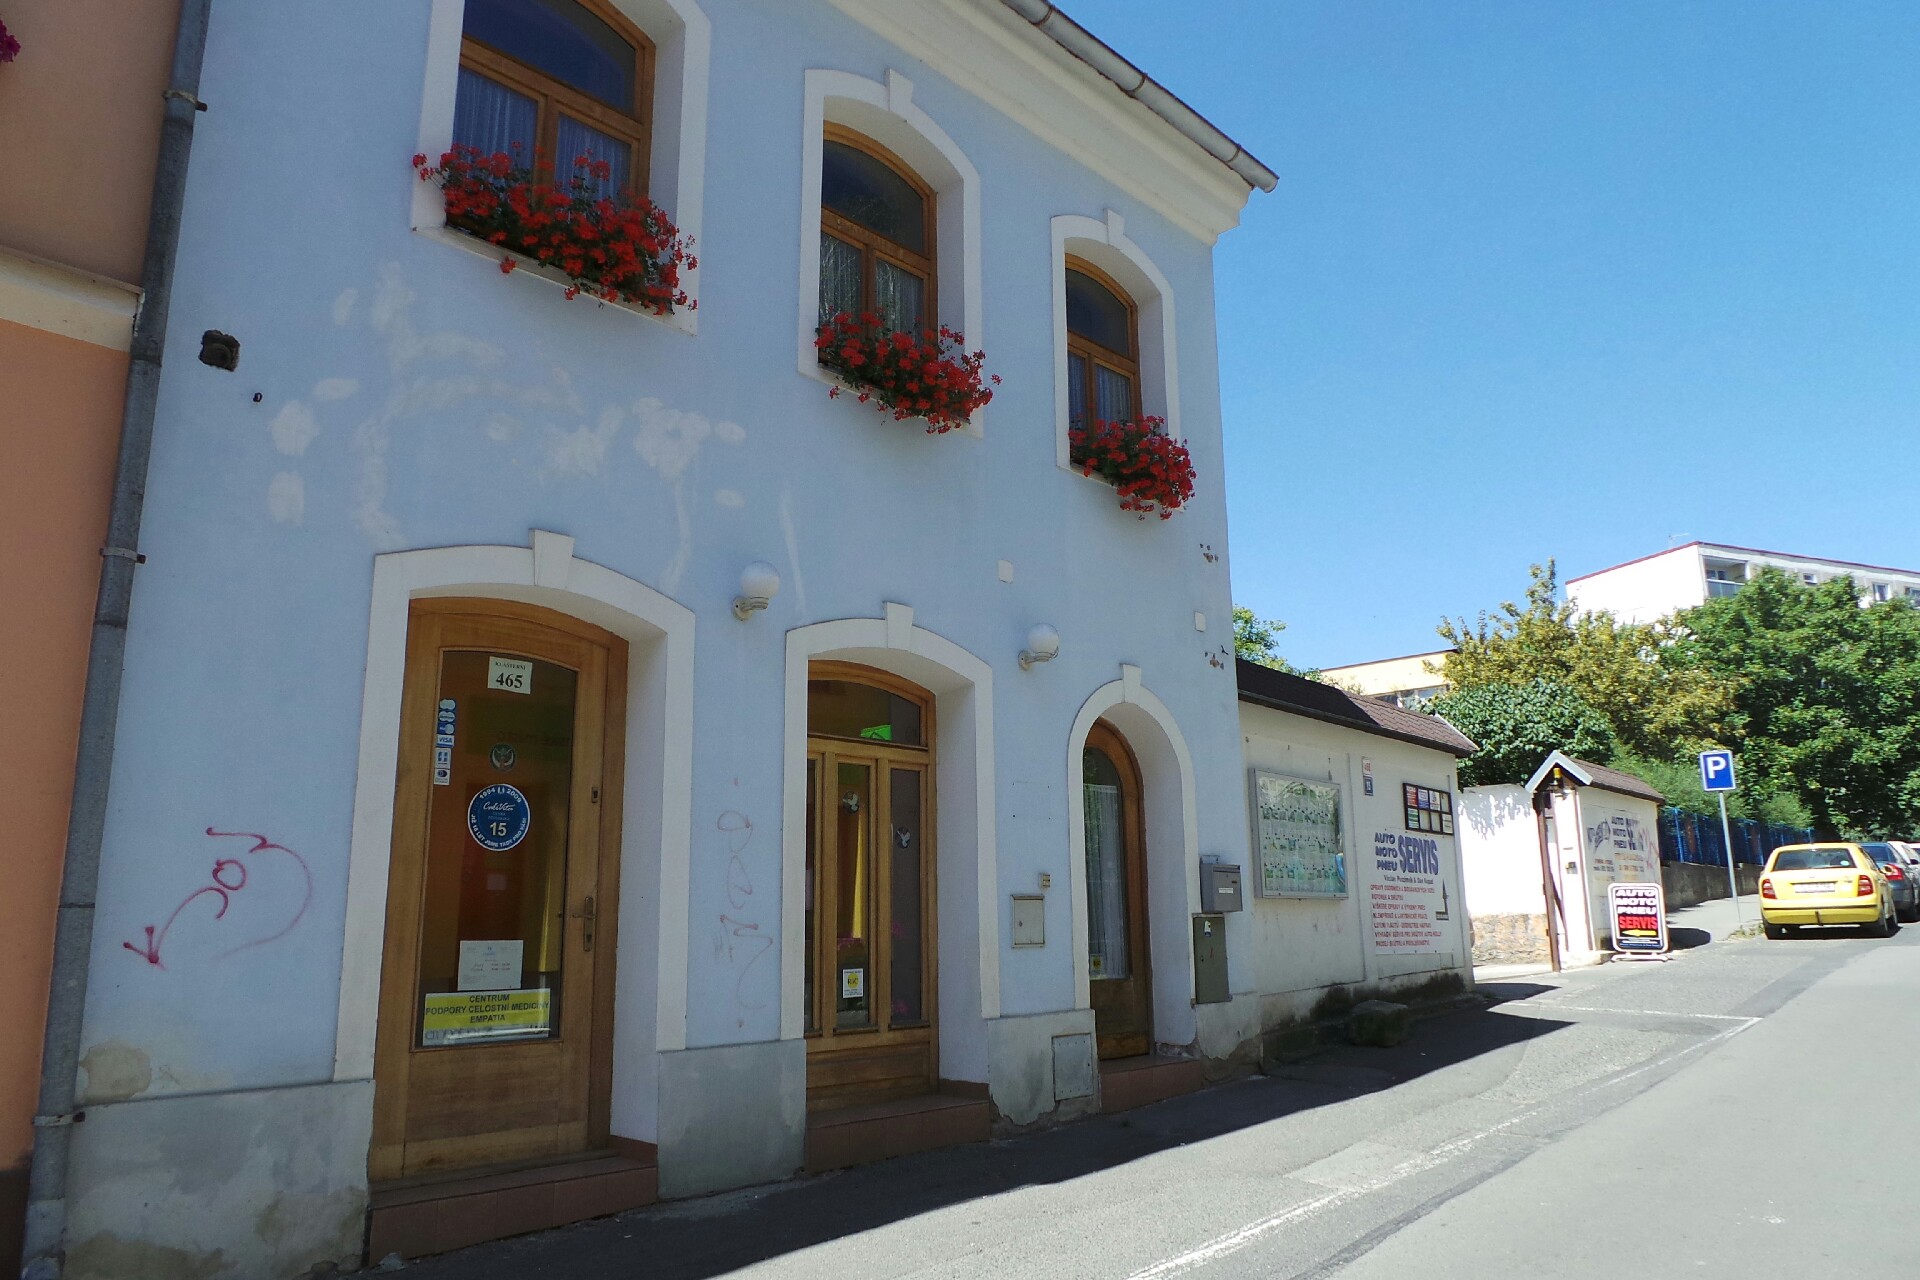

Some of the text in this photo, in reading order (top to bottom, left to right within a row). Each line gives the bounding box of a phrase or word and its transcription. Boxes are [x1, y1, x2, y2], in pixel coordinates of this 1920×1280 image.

[495, 672, 523, 689] 465
[1706, 756, 1727, 779] P
[490, 822, 507, 837] 15
[1374, 832, 1396, 845] AUTO
[1375, 845, 1398, 859] MOTO
[1398, 834, 1439, 876] SERVIS
[1376, 859, 1398, 872] PNEU
[1616, 889, 1656, 897] AUTO
[1616, 897, 1657, 906] MOTO
[1617, 906, 1657, 915] PNEU
[1619, 916, 1658, 929] SERVIS
[469, 994, 510, 1003] CENTRUM
[425, 1004, 467, 1016] PODPORY
[470, 1014, 506, 1024] EMPATIA
